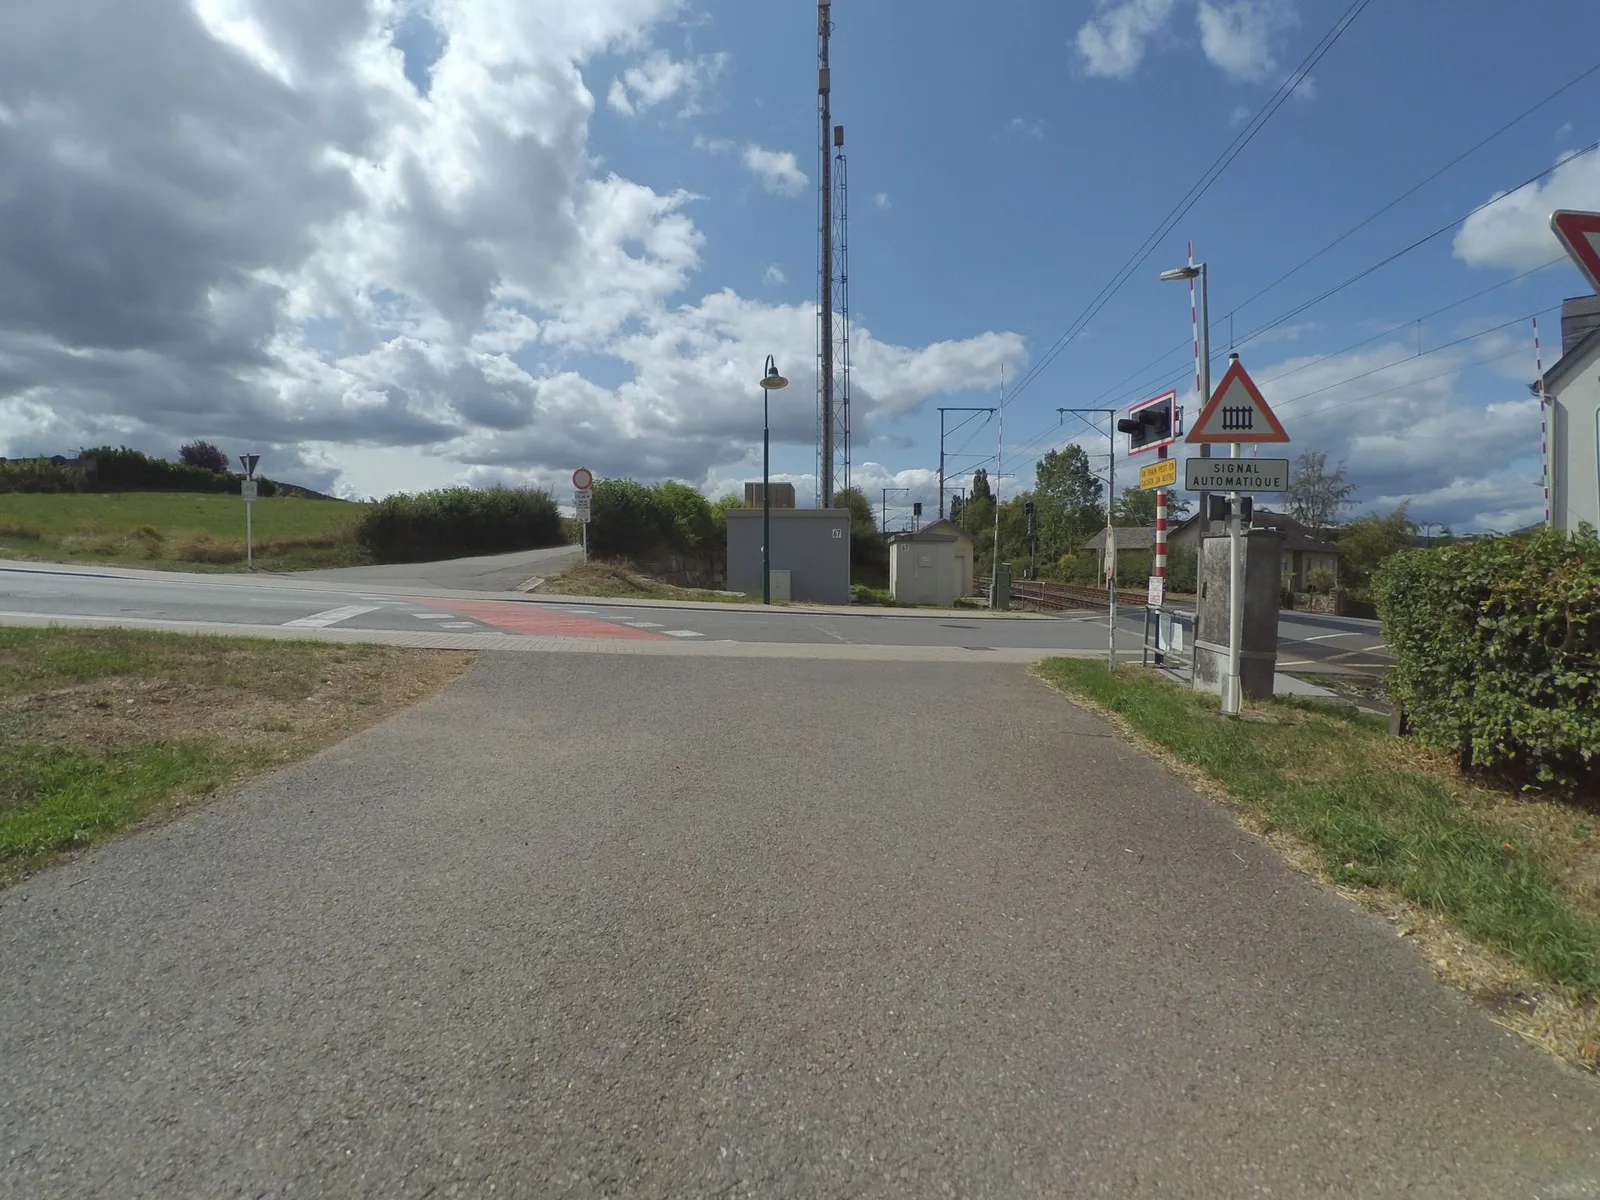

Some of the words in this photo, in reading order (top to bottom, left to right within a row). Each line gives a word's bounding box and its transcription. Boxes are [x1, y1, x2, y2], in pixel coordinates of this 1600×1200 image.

[1214, 464, 1260, 474] SIGNAL
[1192, 476, 1280, 487] AUTOMATIQUE
[833, 529, 840, 538] 67
